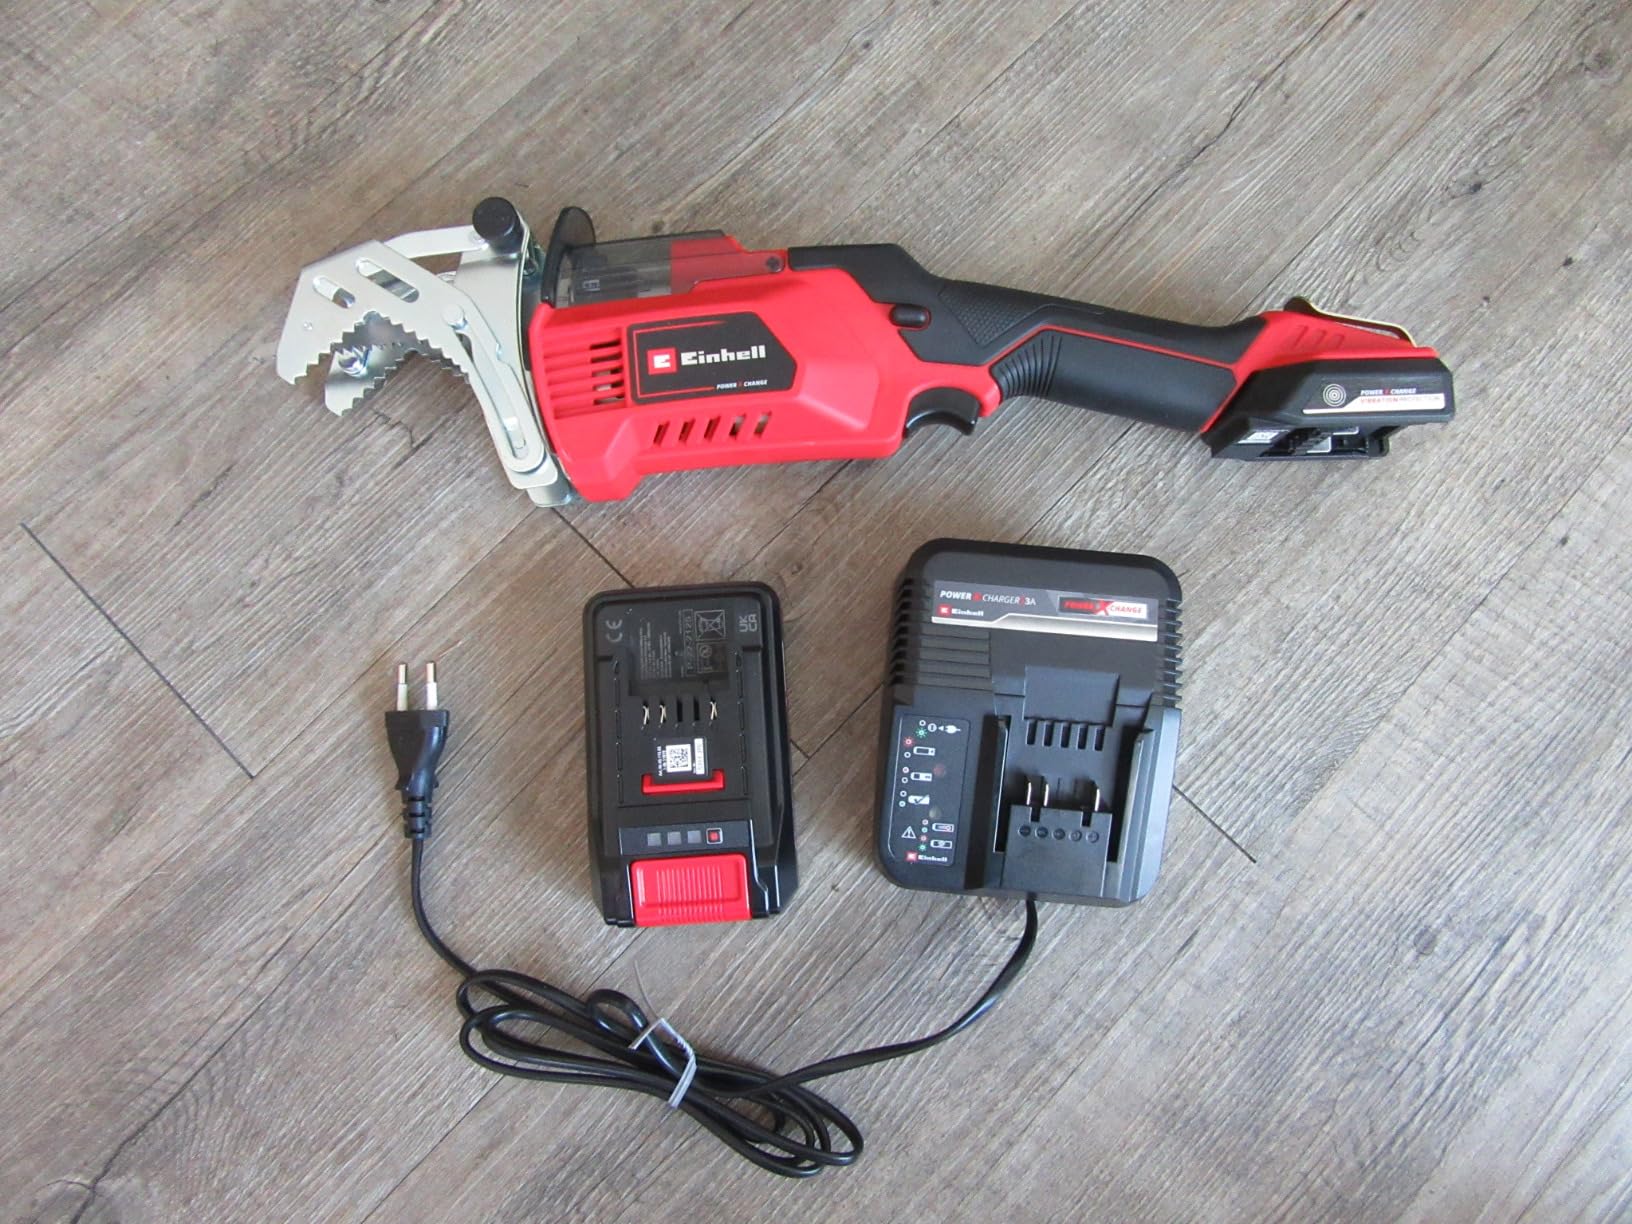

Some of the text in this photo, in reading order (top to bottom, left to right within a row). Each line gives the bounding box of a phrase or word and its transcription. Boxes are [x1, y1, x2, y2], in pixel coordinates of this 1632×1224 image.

[680, 345, 766, 366] Einhell
[743, 379, 768, 387] CHANGE
[1390, 387, 1417, 395] CHANGE
[939, 590, 972, 600] POWER
[982, 593, 1020, 605] CHARGER
[1024, 597, 1037, 606] 3A
[951, 608, 984, 617] Einhell
[1110, 605, 1142, 614] CHANGE
[917, 854, 948, 862] Einhell
